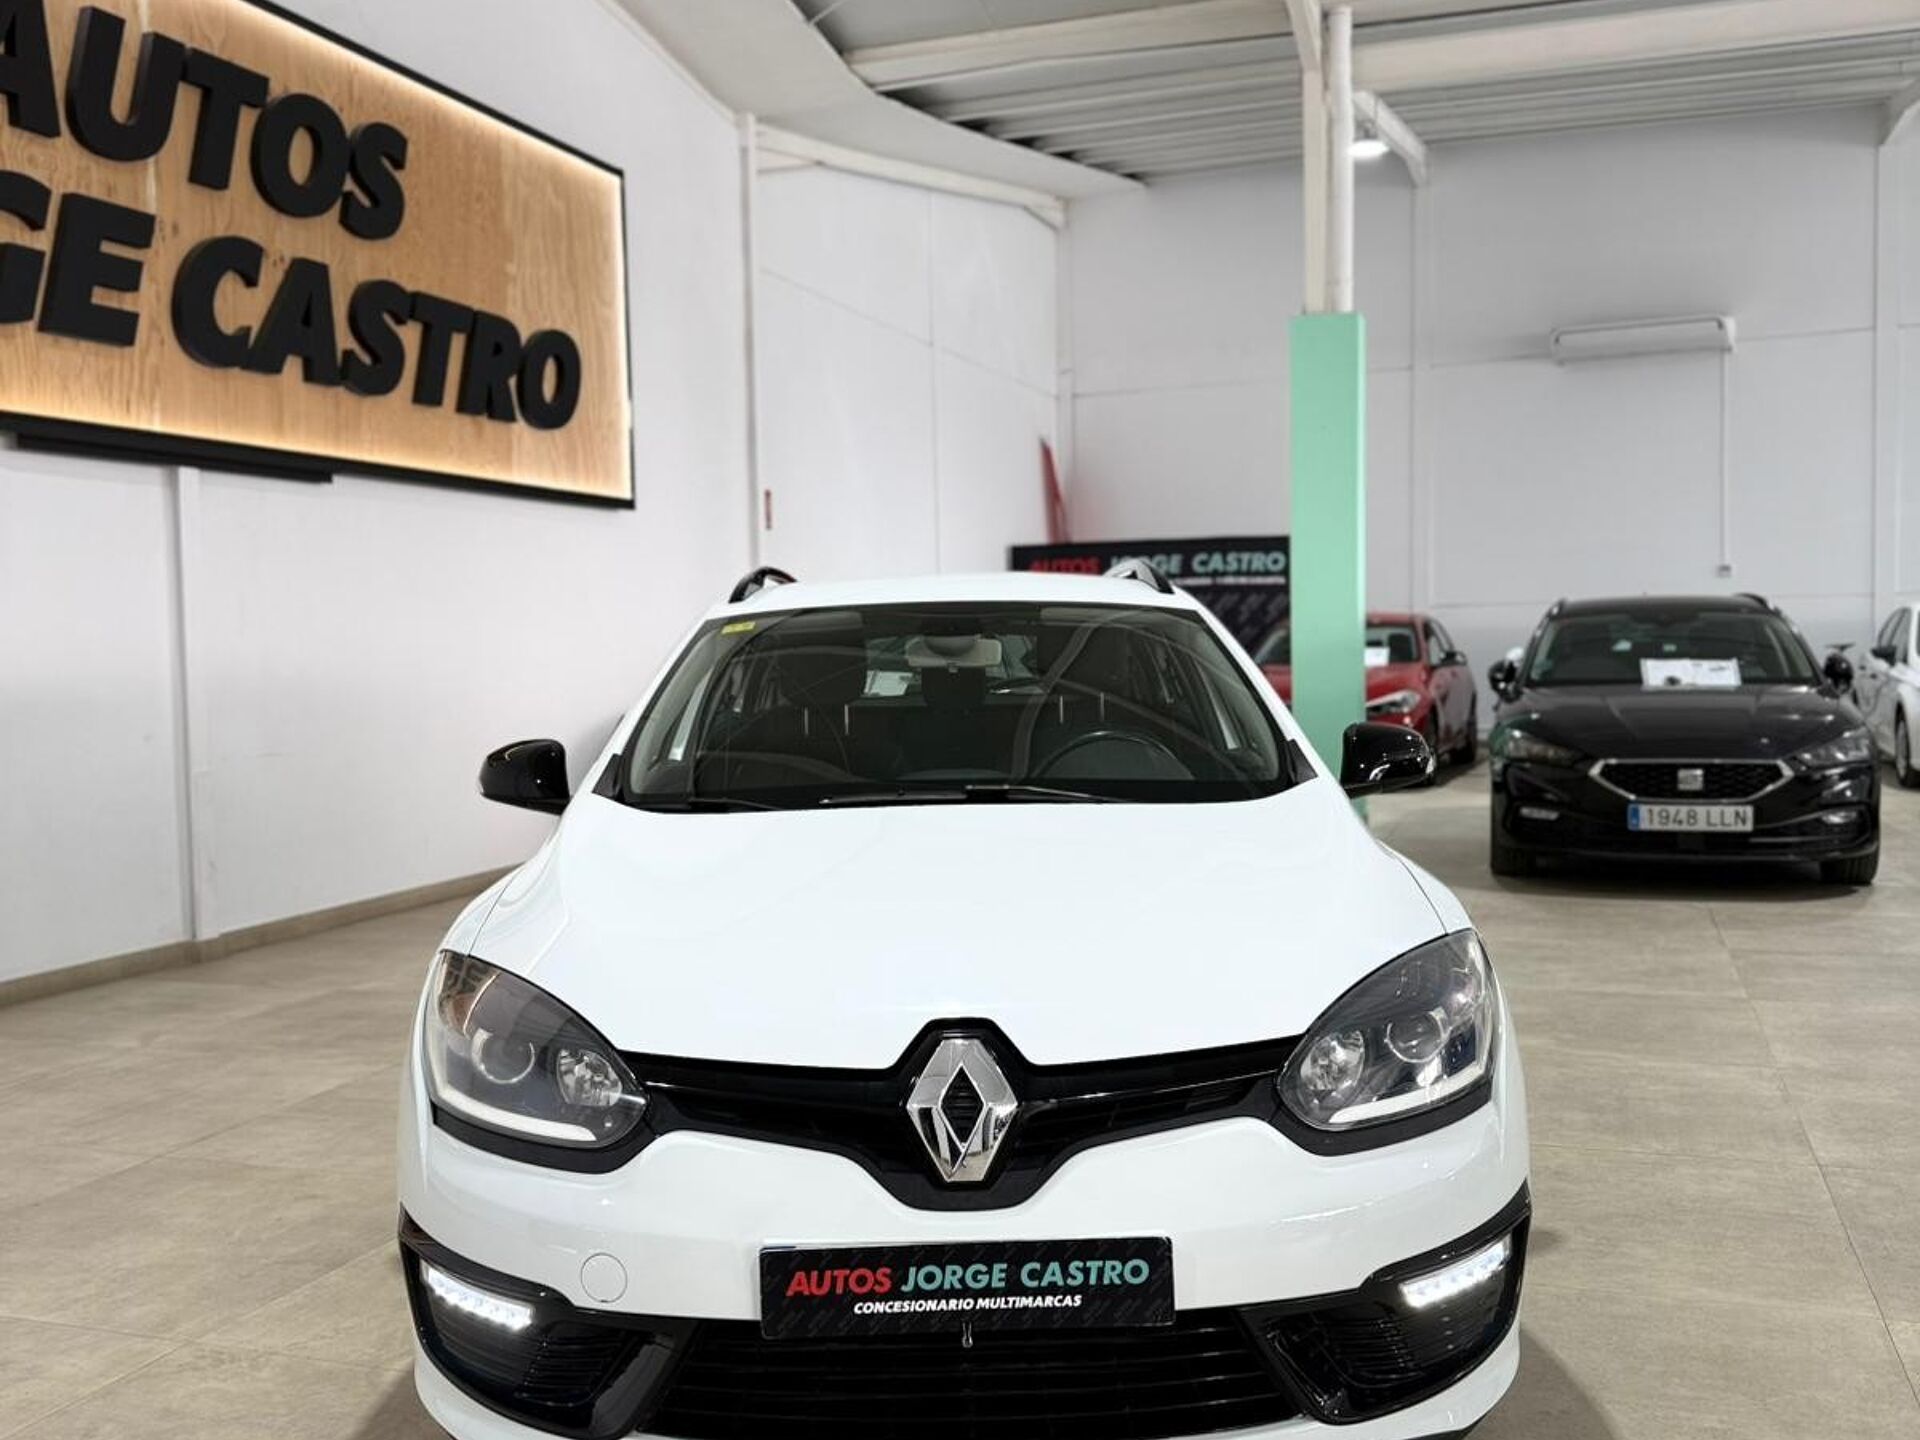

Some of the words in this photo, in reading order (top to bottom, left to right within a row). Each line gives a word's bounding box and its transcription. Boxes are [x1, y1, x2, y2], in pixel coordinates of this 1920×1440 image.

[171, 236, 581, 430] CASTRO
[1191, 552, 1286, 573] CASTRO
[1646, 808, 1698, 827] 1948
[1705, 808, 1747, 827] LLN
[787, 1269, 892, 1296] AUTOS
[901, 1263, 1007, 1292] JORGE
[1020, 1259, 1150, 1288] CASTRO
[854, 1300, 973, 1315] CONCESIONARIO
[976, 1295, 1082, 1310] MULTIMARCAS
